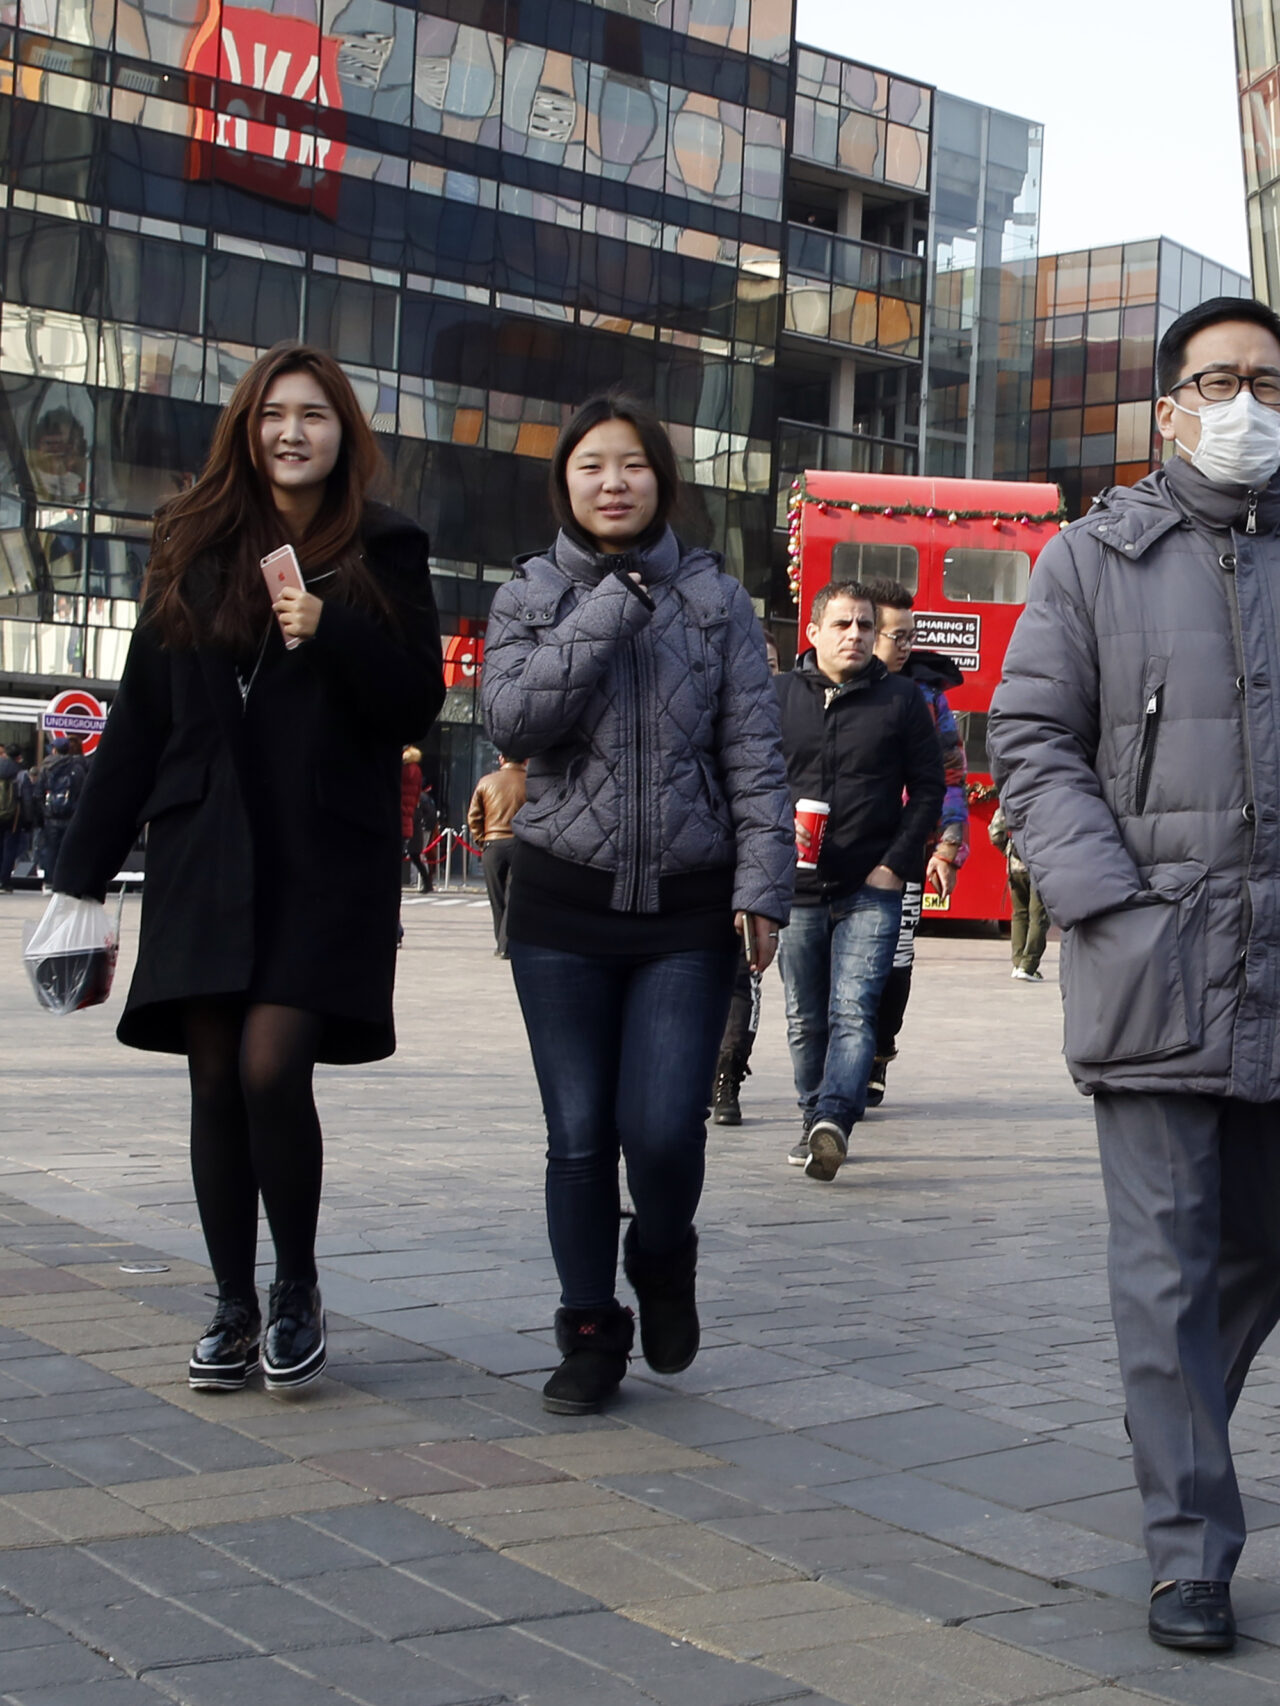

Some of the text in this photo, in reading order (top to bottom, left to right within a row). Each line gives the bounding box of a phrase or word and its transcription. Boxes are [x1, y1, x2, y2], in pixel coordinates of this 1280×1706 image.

[917, 620, 975, 631] SHARING IS
[917, 631, 975, 645] CARING
